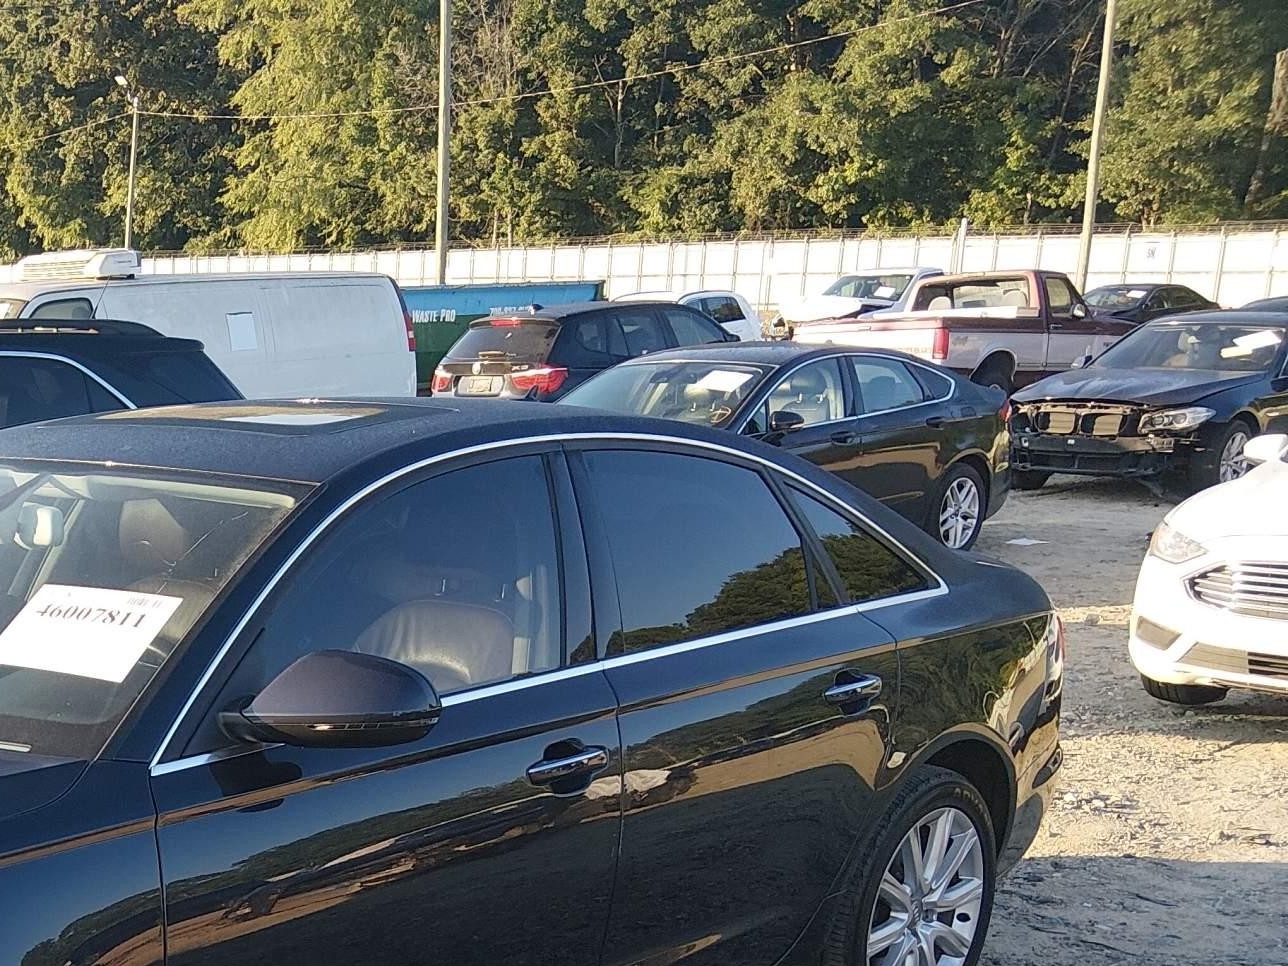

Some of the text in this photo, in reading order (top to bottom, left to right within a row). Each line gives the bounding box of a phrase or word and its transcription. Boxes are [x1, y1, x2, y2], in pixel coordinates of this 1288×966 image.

[412, 309, 456, 324] WASTE PRO
[36, 603, 147, 628] 46007811
